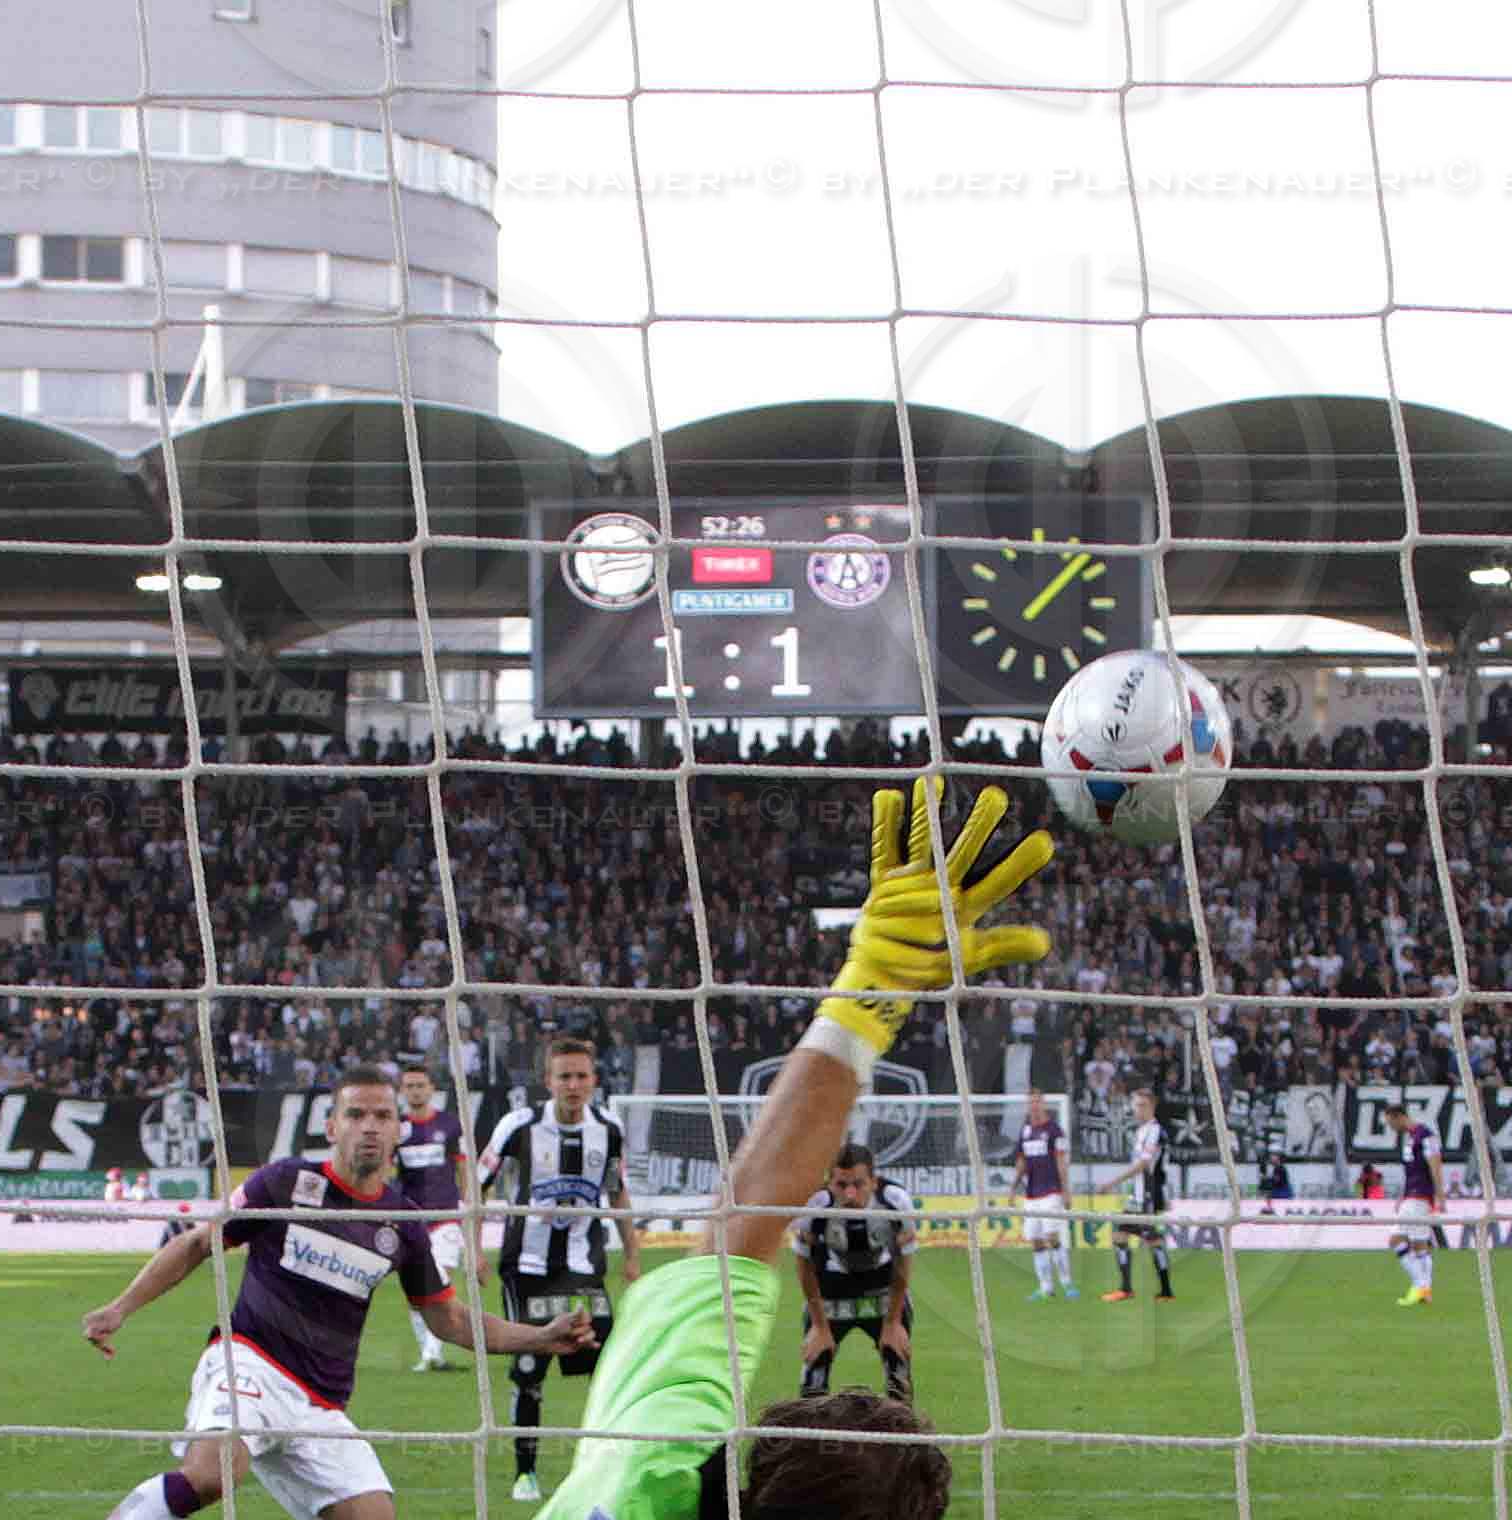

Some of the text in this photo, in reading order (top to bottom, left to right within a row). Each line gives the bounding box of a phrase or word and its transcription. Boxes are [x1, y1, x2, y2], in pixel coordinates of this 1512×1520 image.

[701, 516, 765, 537] 52:26
[654, 628, 694, 698] 1
[771, 627, 811, 696] 1
[294, 1241, 381, 1291] Verbund
